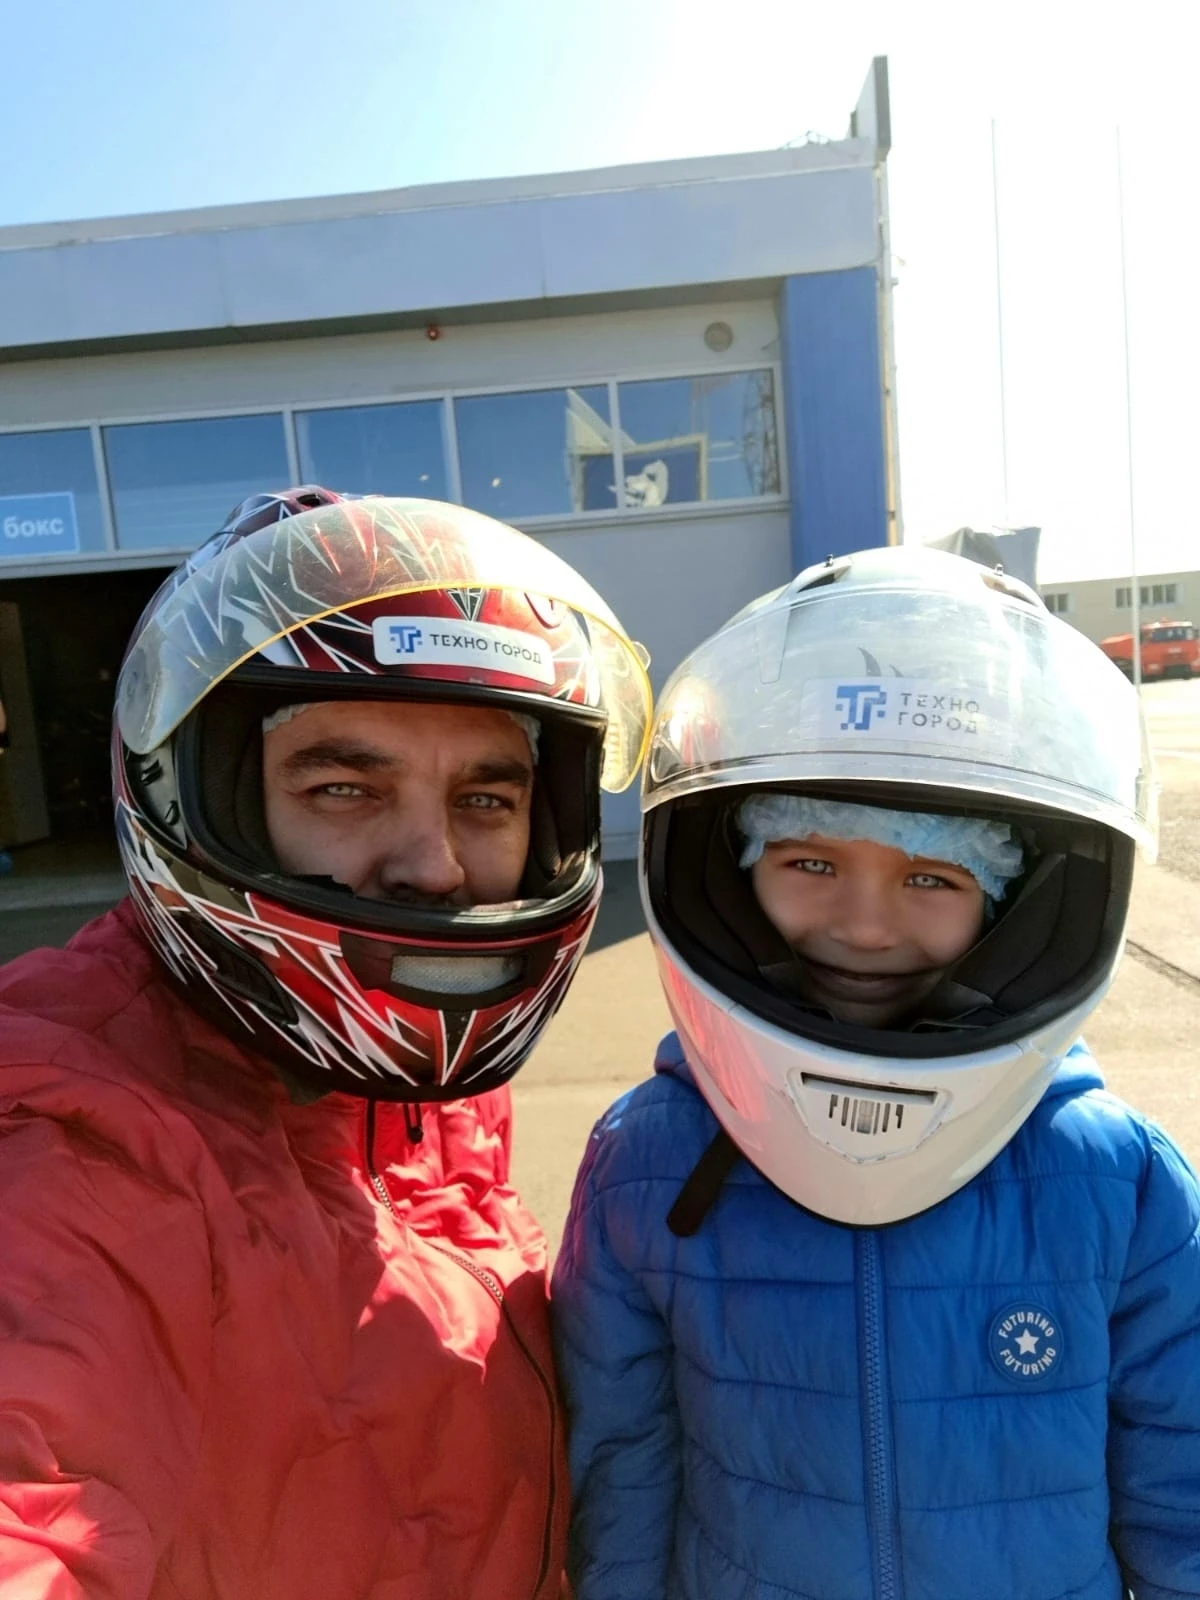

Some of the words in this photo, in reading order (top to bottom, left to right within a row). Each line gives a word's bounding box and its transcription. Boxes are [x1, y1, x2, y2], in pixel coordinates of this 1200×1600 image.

[4, 516, 64, 538] бокс
[429, 633, 488, 650] ТЕХНО
[494, 641, 542, 664] ГОРОД
[901, 693, 980, 713] ТЕХНО
[898, 712, 977, 734] ГОРОД
[998, 1312, 1054, 1338] FUTURINO
[1000, 1347, 1056, 1375] FUTURINO
